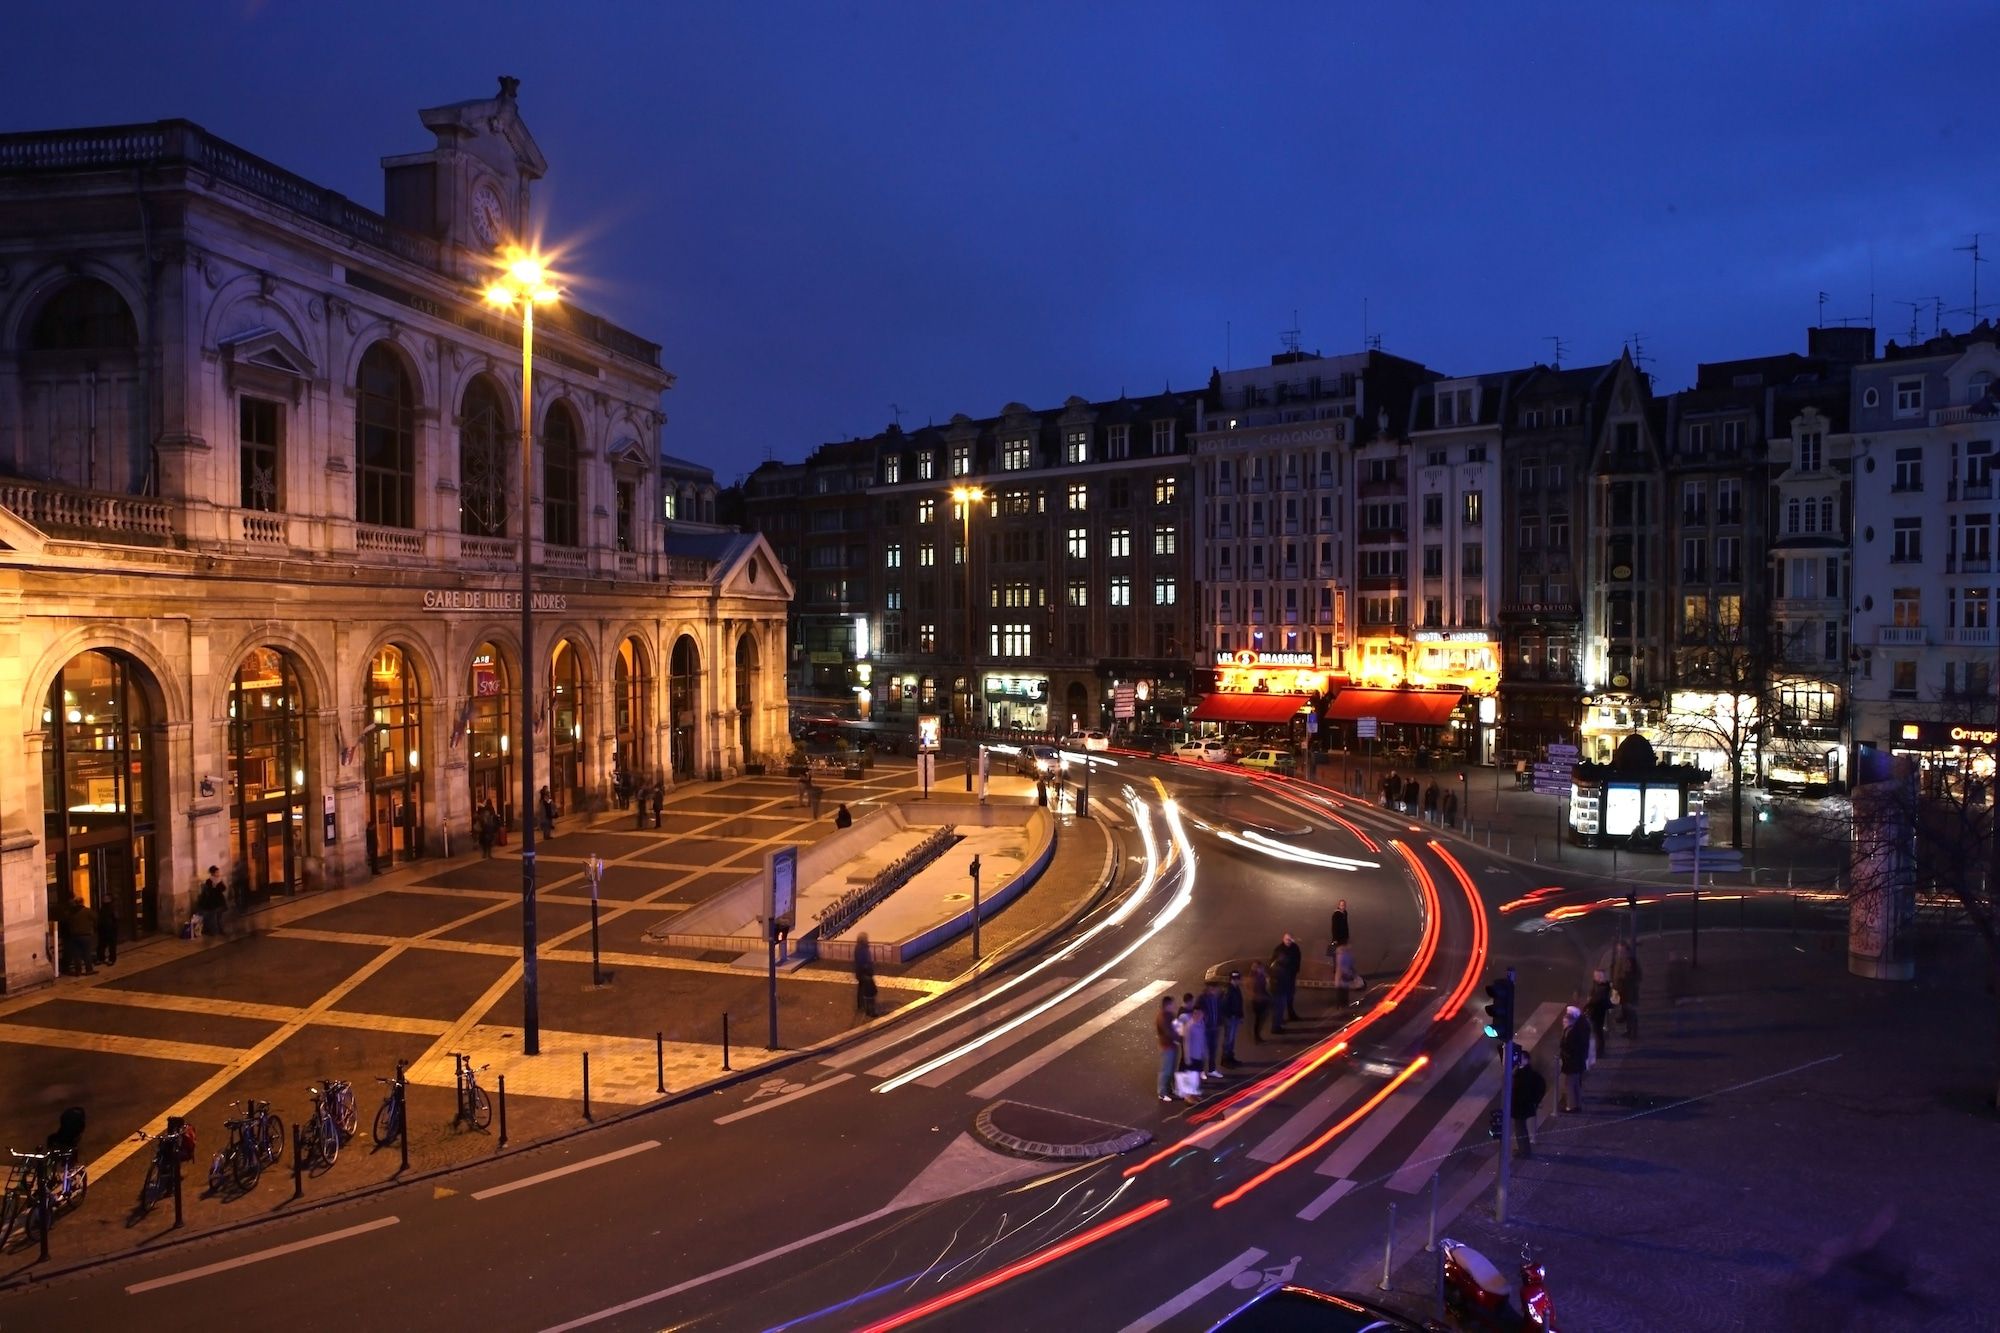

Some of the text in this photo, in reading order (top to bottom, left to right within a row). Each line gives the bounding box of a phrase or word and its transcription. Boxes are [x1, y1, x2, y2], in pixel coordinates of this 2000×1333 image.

[1197, 427, 1335, 453] HOTEL CHAGNOT
[423, 590, 459, 608] GARE
[465, 592, 480, 608] DE
[485, 592, 511, 609] LILLE
[1542, 603, 1573, 611] ARTOIS
[1217, 652, 1233, 663] LES
[1259, 653, 1313, 664] BRASSEURS
